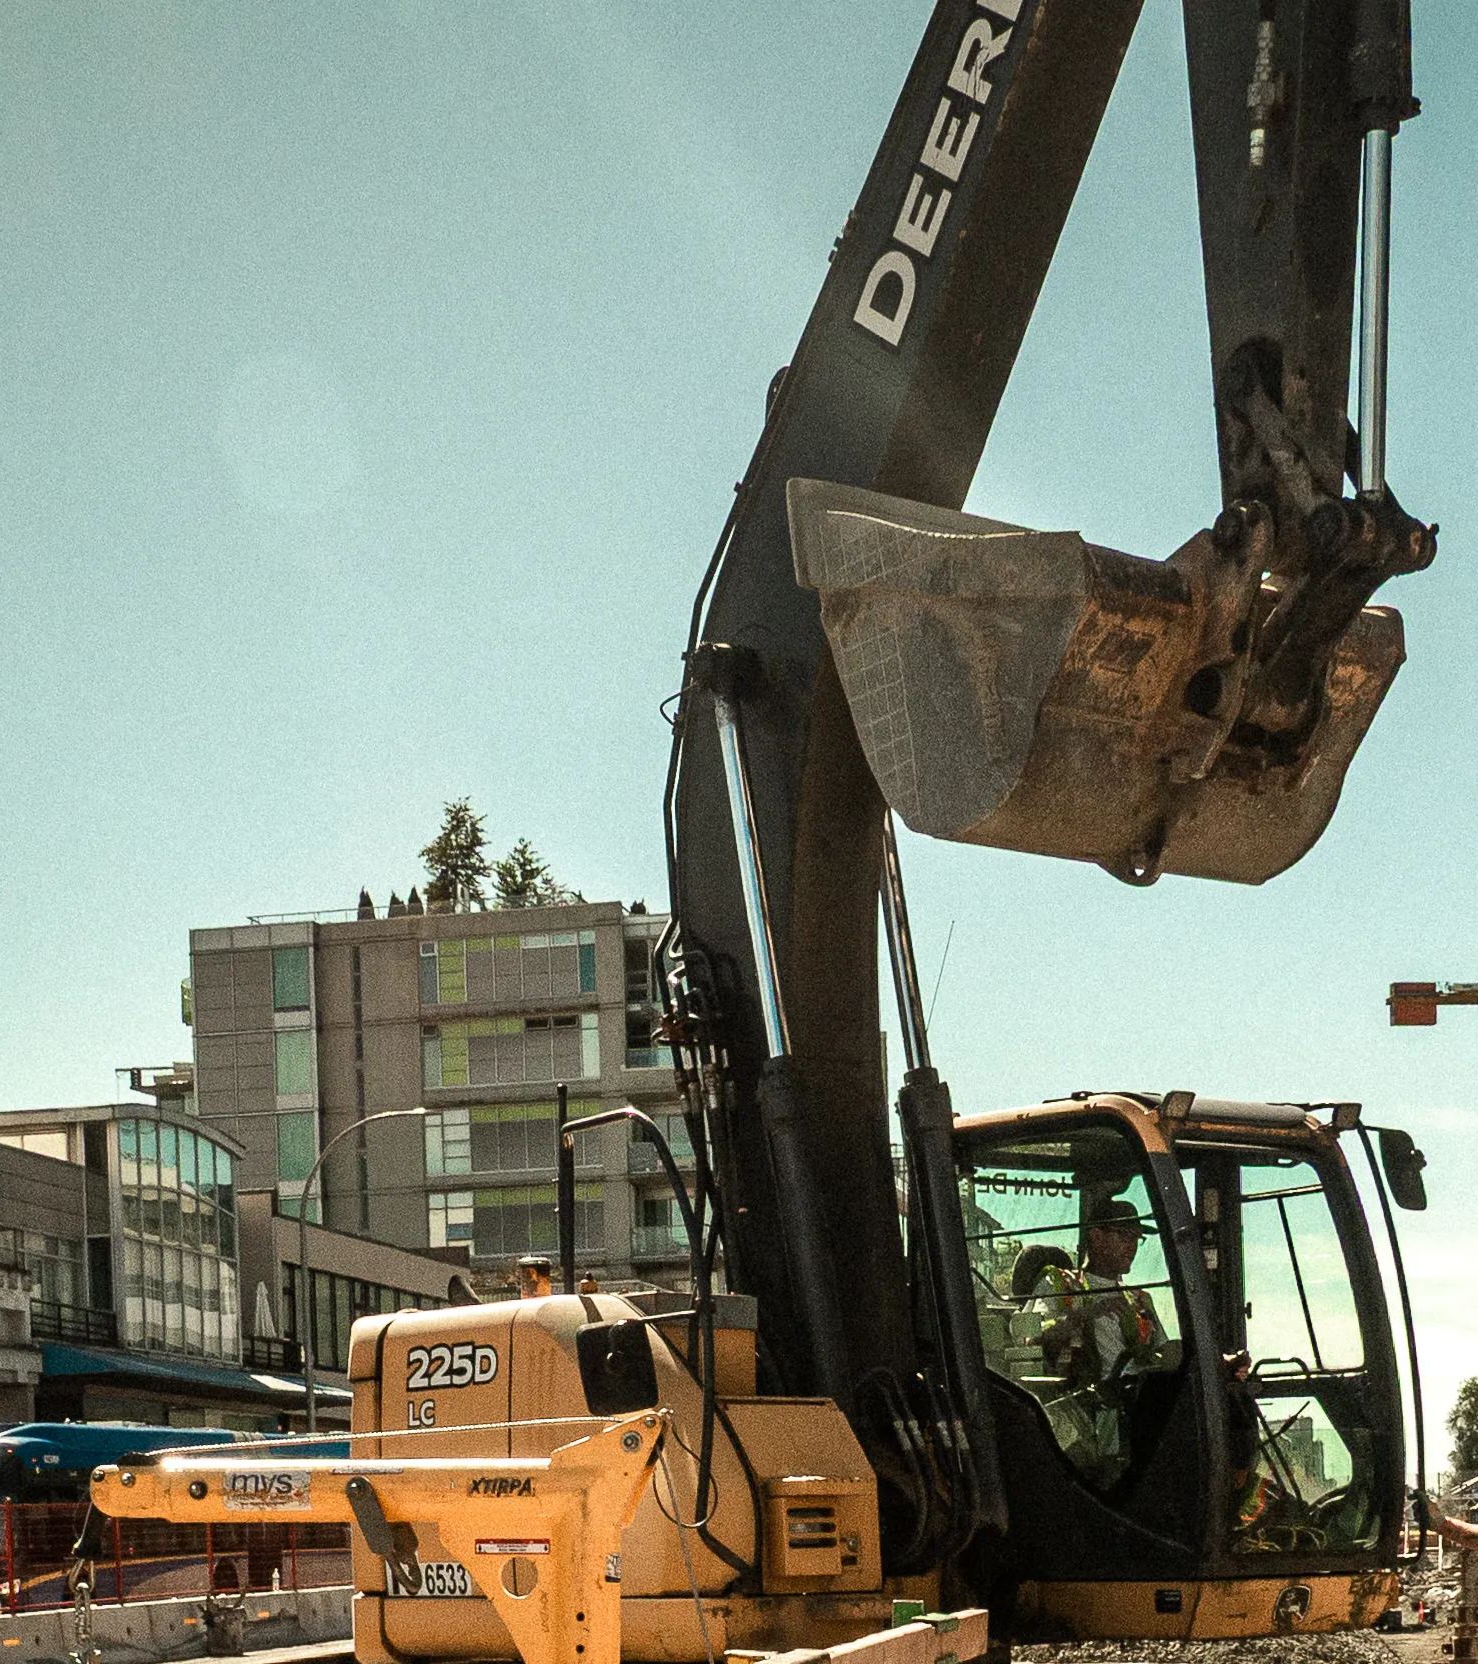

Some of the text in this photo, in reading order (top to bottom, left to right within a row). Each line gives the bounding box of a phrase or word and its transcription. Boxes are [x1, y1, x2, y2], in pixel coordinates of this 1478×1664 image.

[407, 1342, 498, 1391] 225D
[408, 1400, 435, 1427] LC
[231, 1472, 293, 1495] mvs
[471, 1477, 533, 1498] XTIRPA
[425, 1563, 468, 1595] 6533
